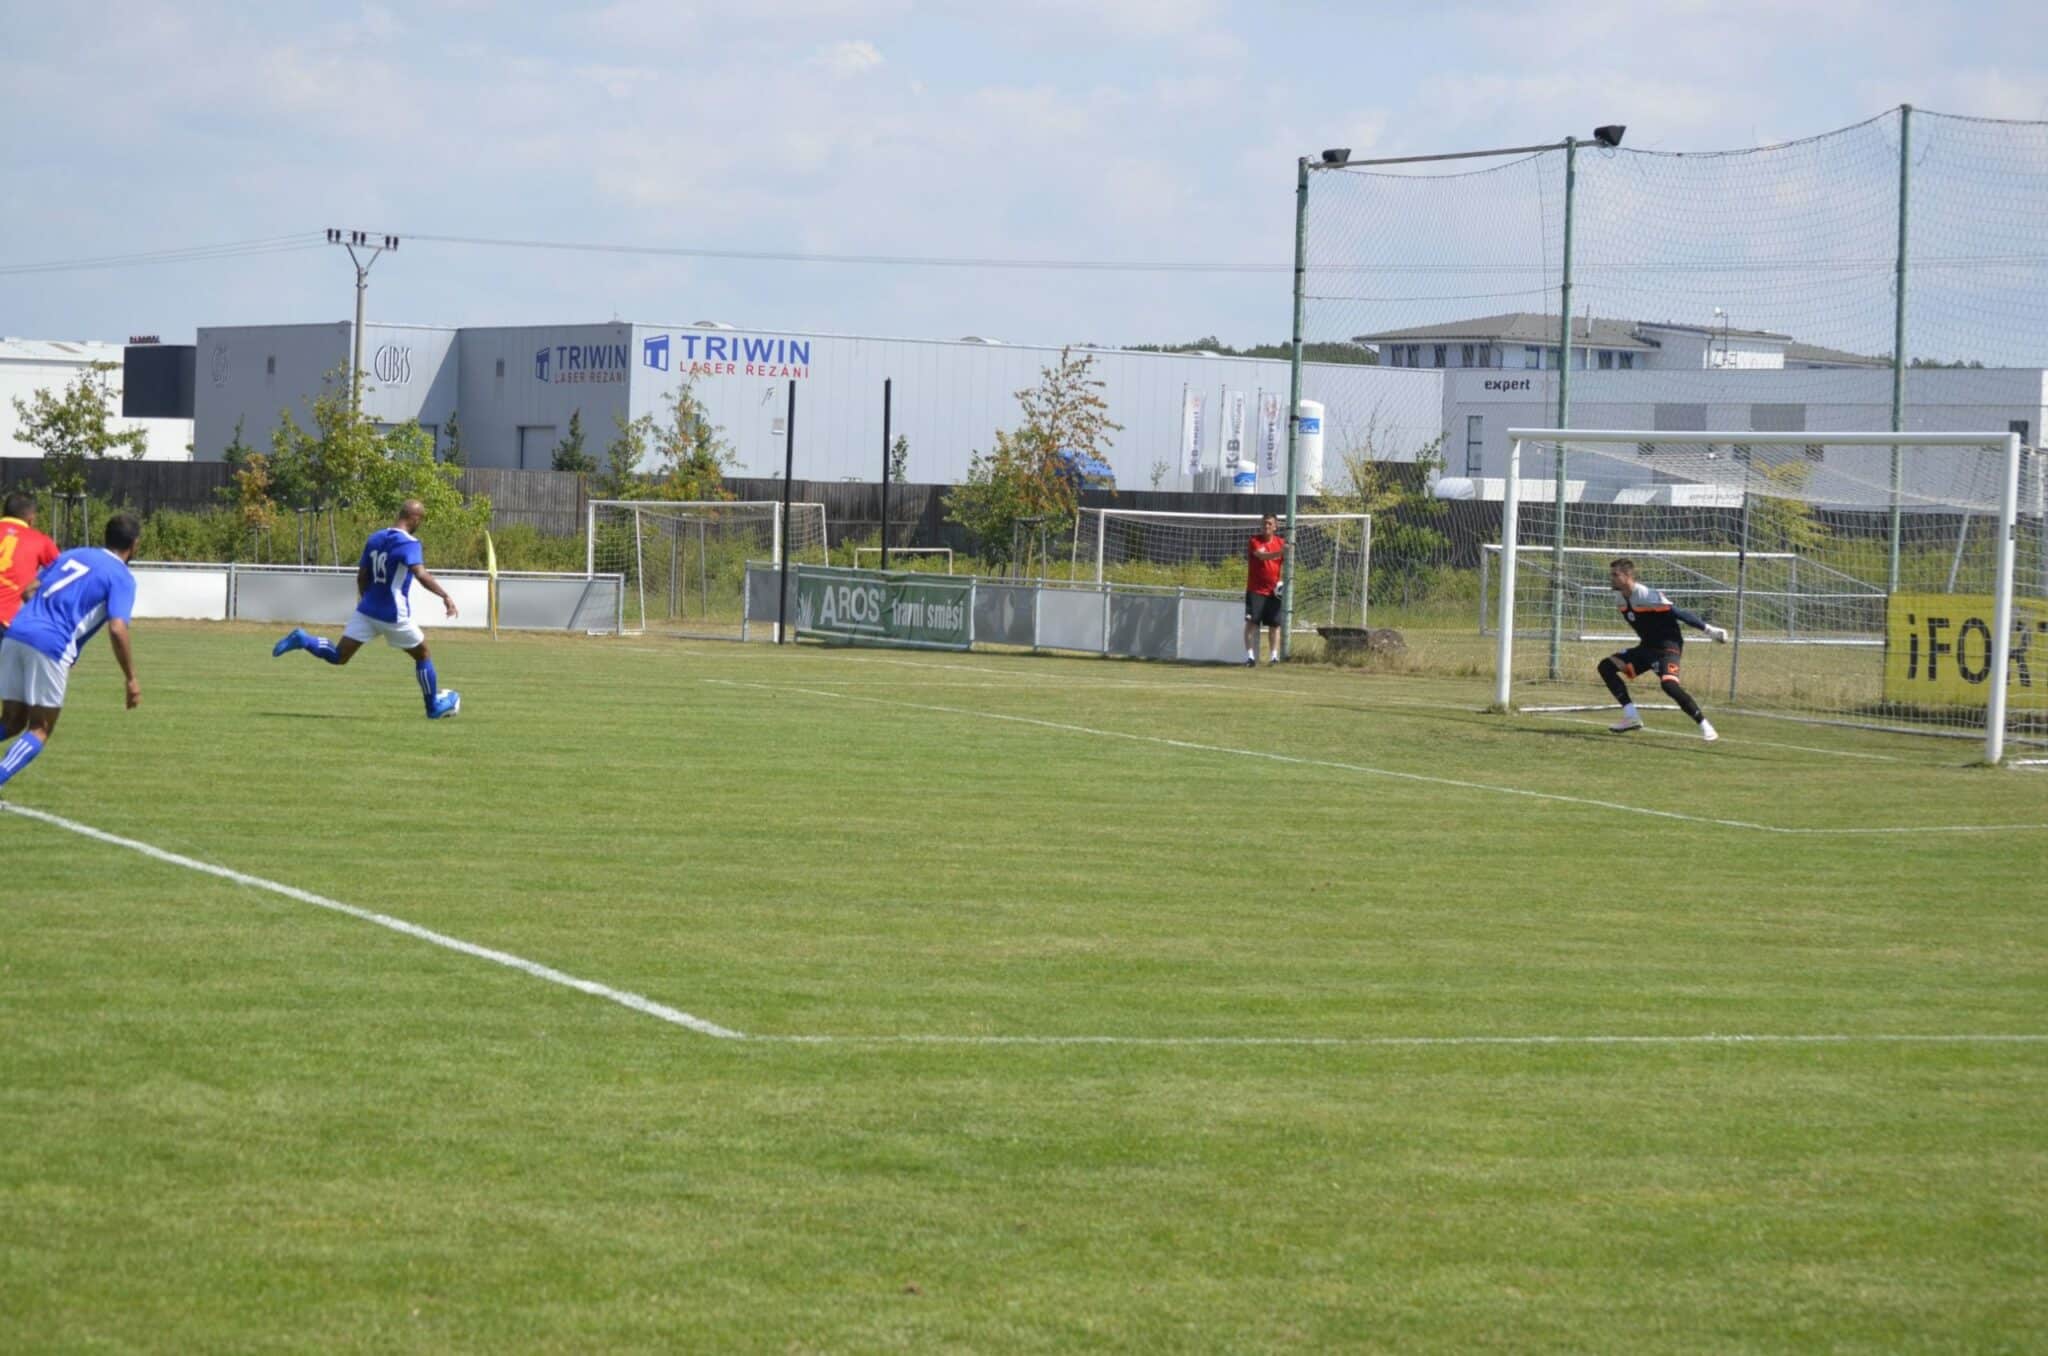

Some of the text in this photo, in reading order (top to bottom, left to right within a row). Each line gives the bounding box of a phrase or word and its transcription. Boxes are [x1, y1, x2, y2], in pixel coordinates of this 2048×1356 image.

[555, 344, 628, 370] TRIWIN
[680, 335, 810, 365] TRIWIN
[680, 361, 735, 375] LASER
[1484, 379, 1530, 392] expert
[42, 558, 91, 598] 7
[820, 585, 881, 625] AROS
